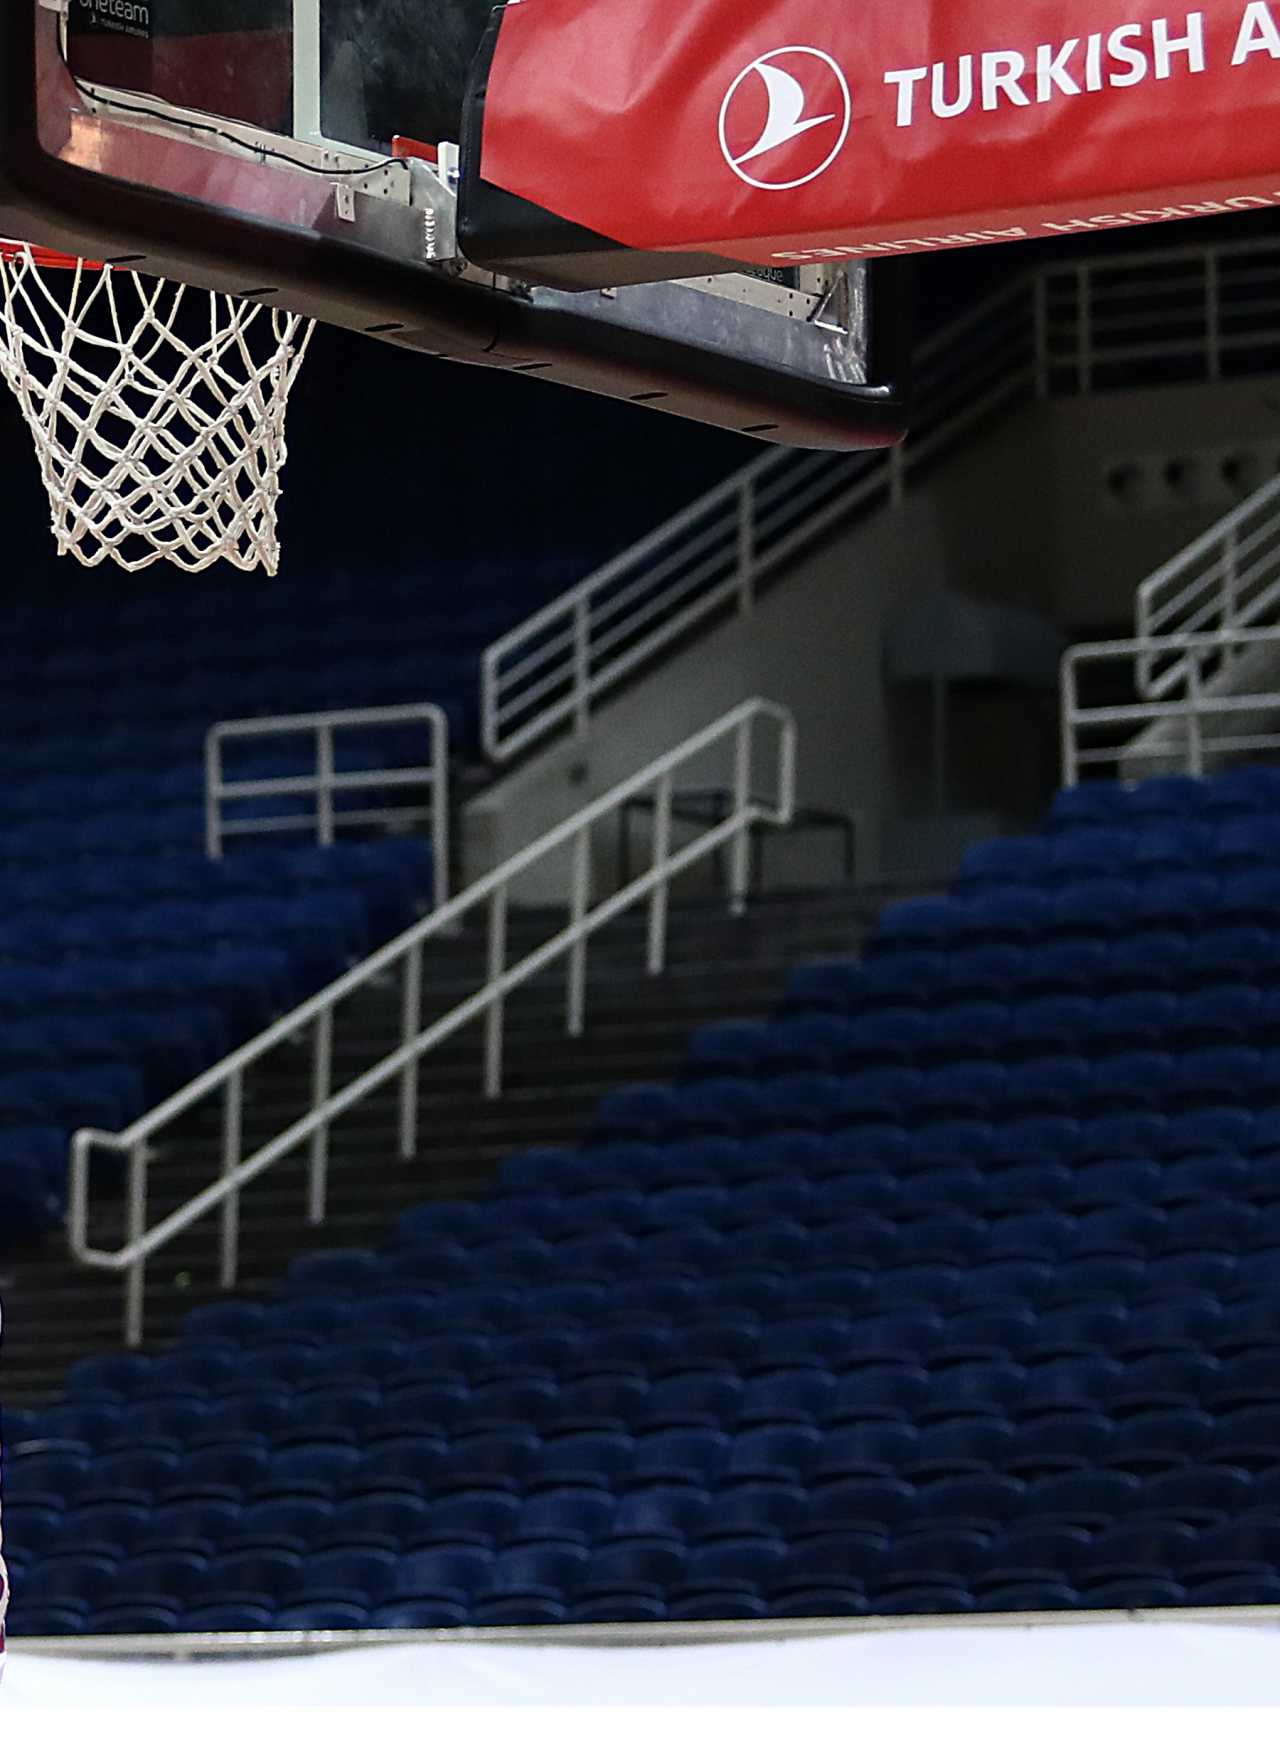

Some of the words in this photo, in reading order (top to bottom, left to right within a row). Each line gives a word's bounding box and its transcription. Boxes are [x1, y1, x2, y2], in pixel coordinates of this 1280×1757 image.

[883, 11, 1206, 127] TURKISH
[1041, 191, 1280, 232] URKISH
[771, 226, 1028, 261] AIRLINES
